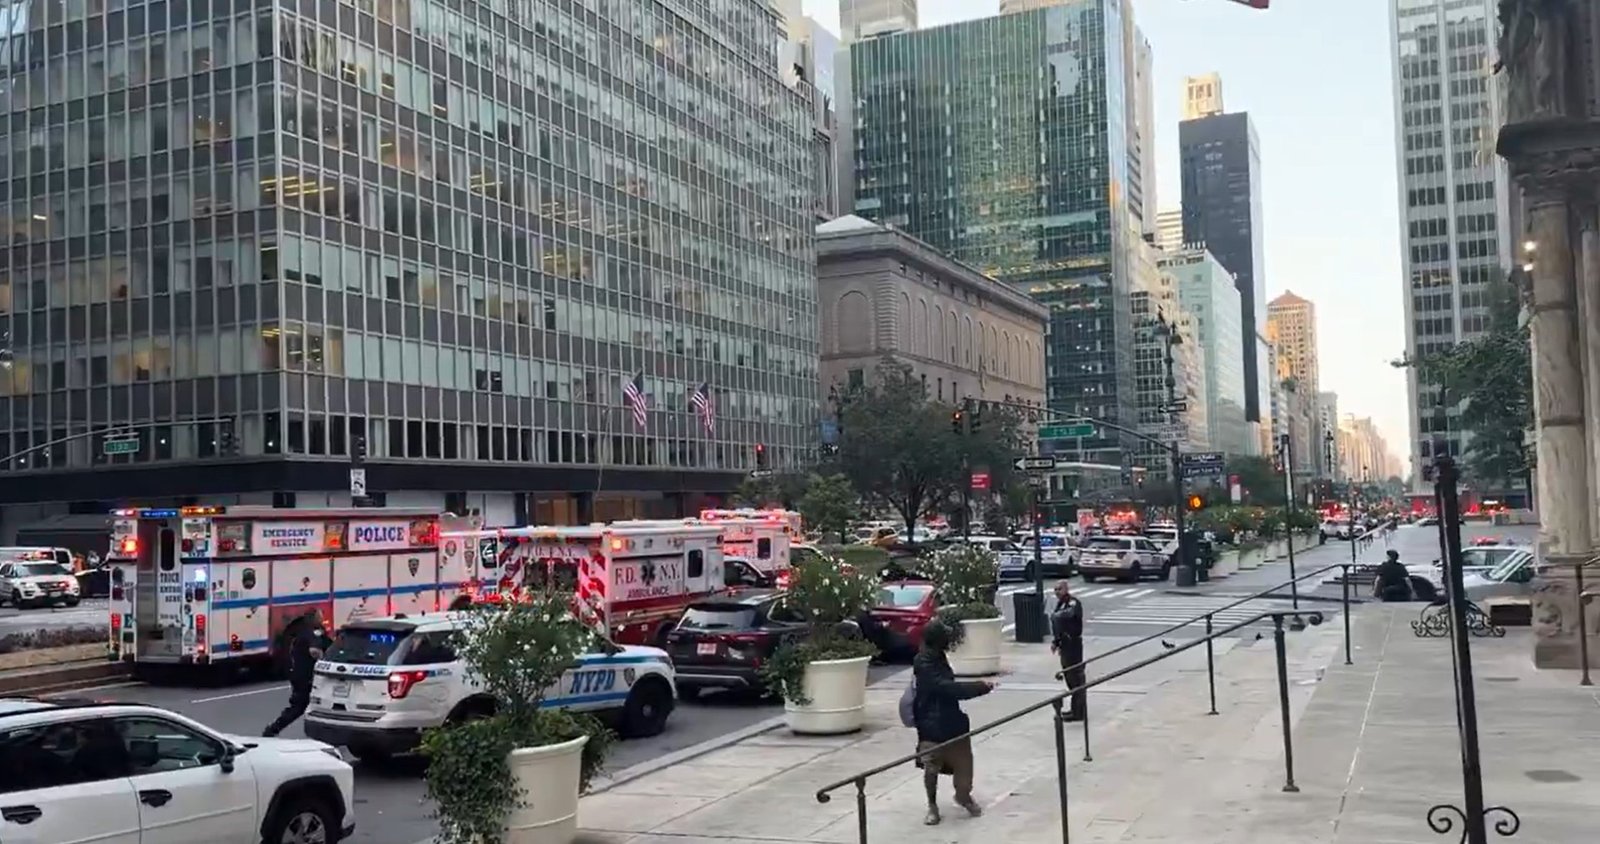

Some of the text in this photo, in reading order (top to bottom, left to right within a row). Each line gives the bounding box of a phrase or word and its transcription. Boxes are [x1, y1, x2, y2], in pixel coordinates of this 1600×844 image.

[263, 528, 314, 538] EMERGENCY
[354, 526, 404, 543] POLICE
[271, 538, 306, 548] SERVICE
[614, 562, 680, 587] F.D. N.Y.
[627, 587, 669, 598] AMBULANCE
[352, 666, 387, 675] POLICE
[569, 669, 616, 694] NYPD
